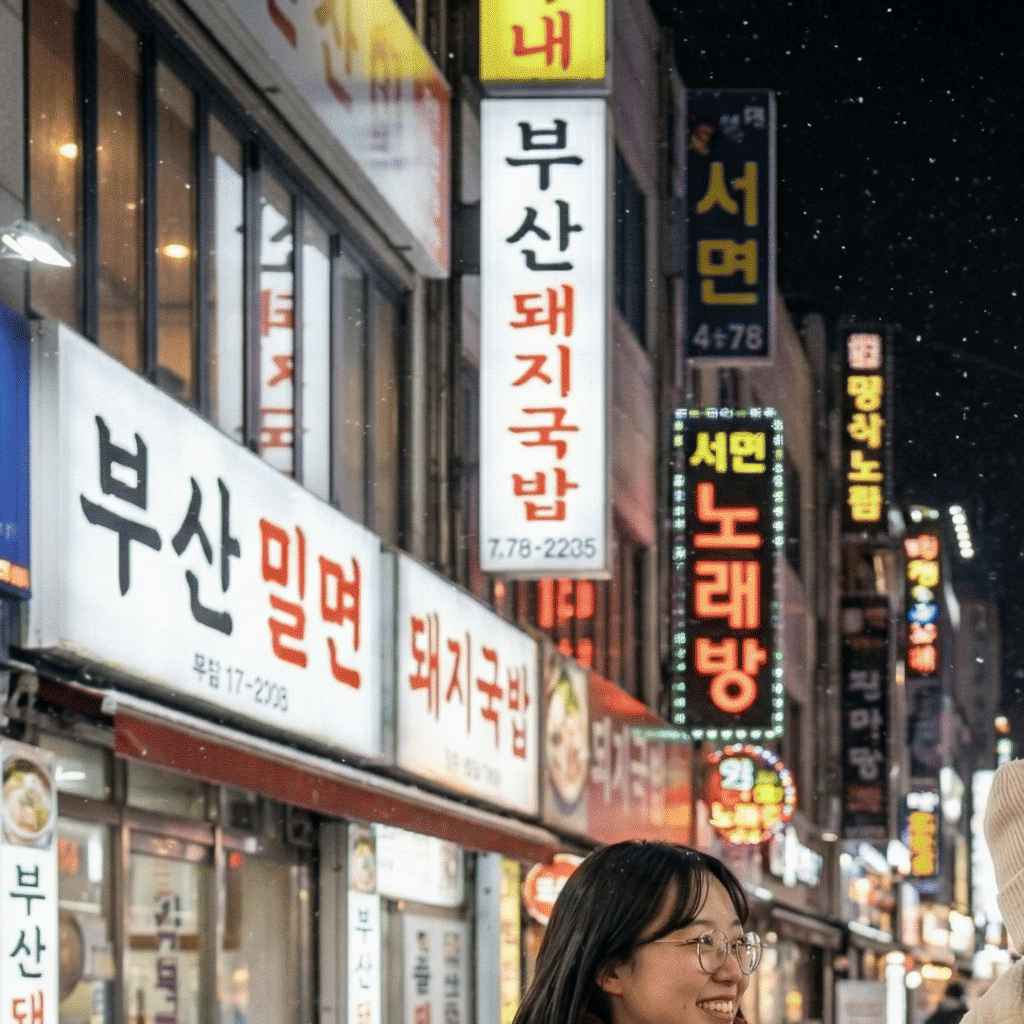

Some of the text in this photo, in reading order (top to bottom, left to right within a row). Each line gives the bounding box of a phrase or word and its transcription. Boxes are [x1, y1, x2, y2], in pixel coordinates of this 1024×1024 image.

[505, 118, 584, 522] 부산돼지국밥
[696, 161, 759, 305] 서면
[689, 431, 766, 474] 서면
[79, 415, 242, 637] 부산
[258, 517, 363, 690] 밀면
[693, 481, 766, 714] 노래방
[409, 611, 529, 760] 돼지국밥
